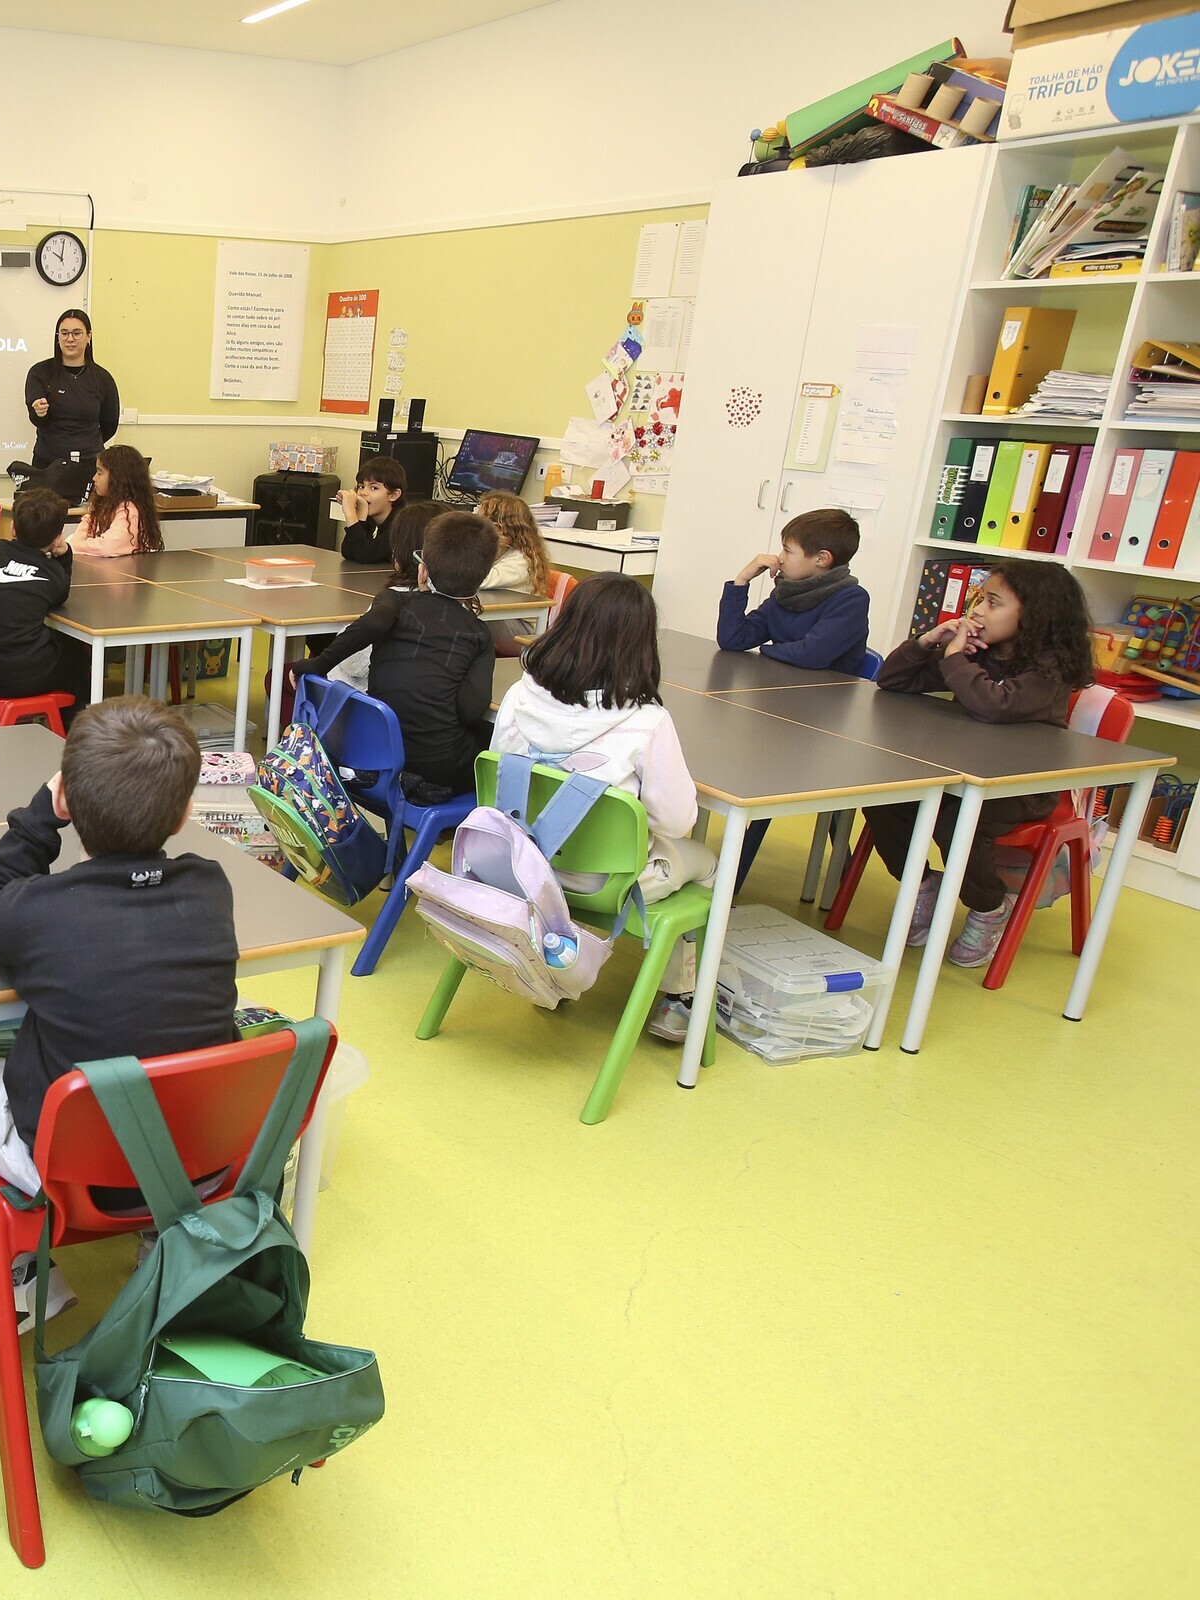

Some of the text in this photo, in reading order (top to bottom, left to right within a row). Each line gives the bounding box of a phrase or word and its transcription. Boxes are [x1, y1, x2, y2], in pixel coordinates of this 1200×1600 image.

[1030, 64, 1103, 85] TOALHA DE MÃO
[1028, 76, 1098, 100] TRIFOLD
[4, 560, 39, 577] NIKE
